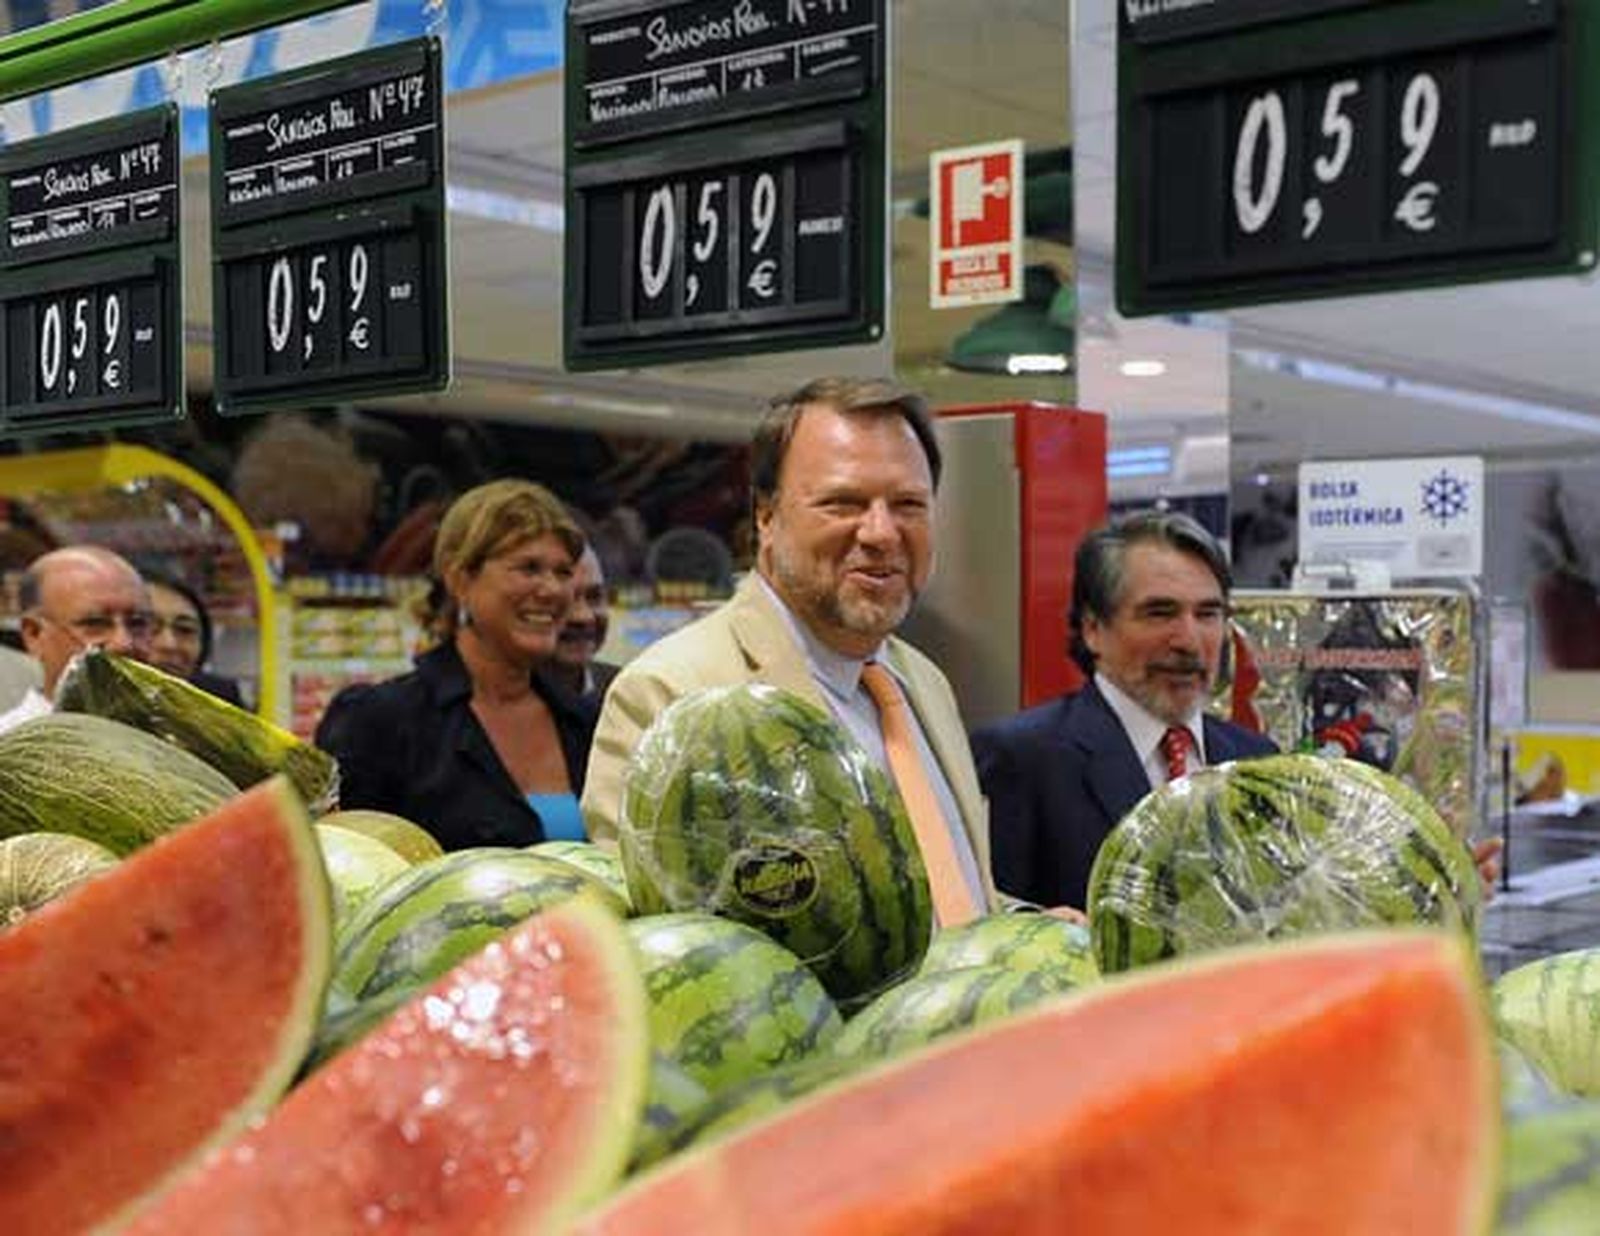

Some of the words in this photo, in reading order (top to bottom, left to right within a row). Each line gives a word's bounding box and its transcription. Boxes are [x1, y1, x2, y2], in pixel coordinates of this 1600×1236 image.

[1232, 72, 1440, 239] 0,59
[640, 172, 777, 306] 0,59
[41, 294, 120, 394] 0,59
[267, 244, 368, 361] 0,59
